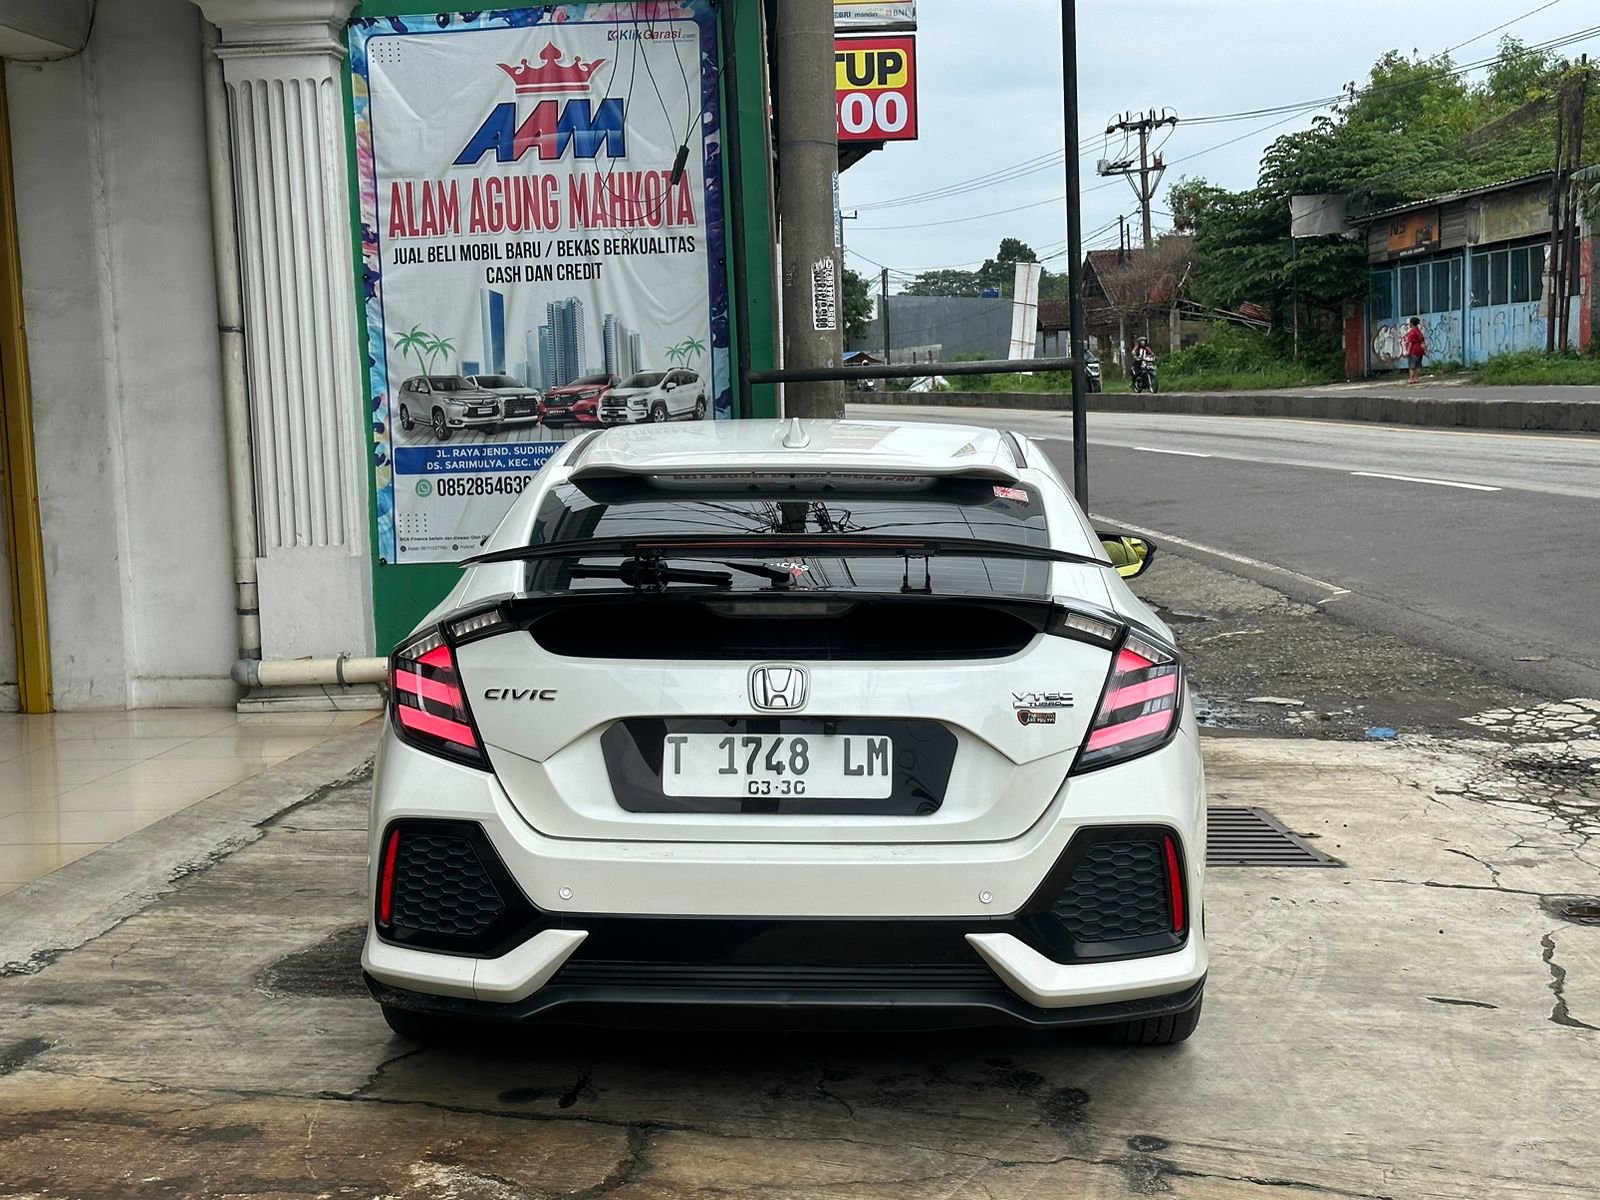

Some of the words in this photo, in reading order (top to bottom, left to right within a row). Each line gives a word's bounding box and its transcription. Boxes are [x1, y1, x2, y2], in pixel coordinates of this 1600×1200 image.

[452, 98, 626, 165] AAM
[388, 179, 461, 238] ALAM
[469, 173, 559, 233] AGUNG
[569, 169, 696, 229] MAHKOTA
[393, 245, 424, 264] JUAL
[428, 243, 457, 263] BELI
[460, 242, 502, 261] MOBIL
[506, 241, 541, 260] BARU
[545, 240, 552, 258] /
[557, 238, 600, 257] BEKAS
[604, 235, 695, 255] BERKUALITAS
[486, 265, 520, 284] CASH
[525, 264, 552, 282] DAN
[557, 262, 602, 281] CREDIT
[436, 449, 450, 458] JL.
[453, 448, 480, 457] RAYA
[482, 447, 511, 456] JEND.
[514, 445, 561, 455] SUDIRMA
[427, 461, 442, 470] DS.
[445, 459, 506, 469] SARIMULYA,
[508, 458, 531, 467] KEC.
[534, 457, 549, 466] KO
[437, 476, 531, 496] 0852854636
[484, 688, 559, 700] CIVIC
[1011, 691, 1074, 701] VTEC
[667, 736, 688, 774] T
[718, 736, 810, 775] 1748
[844, 737, 888, 776] LM
